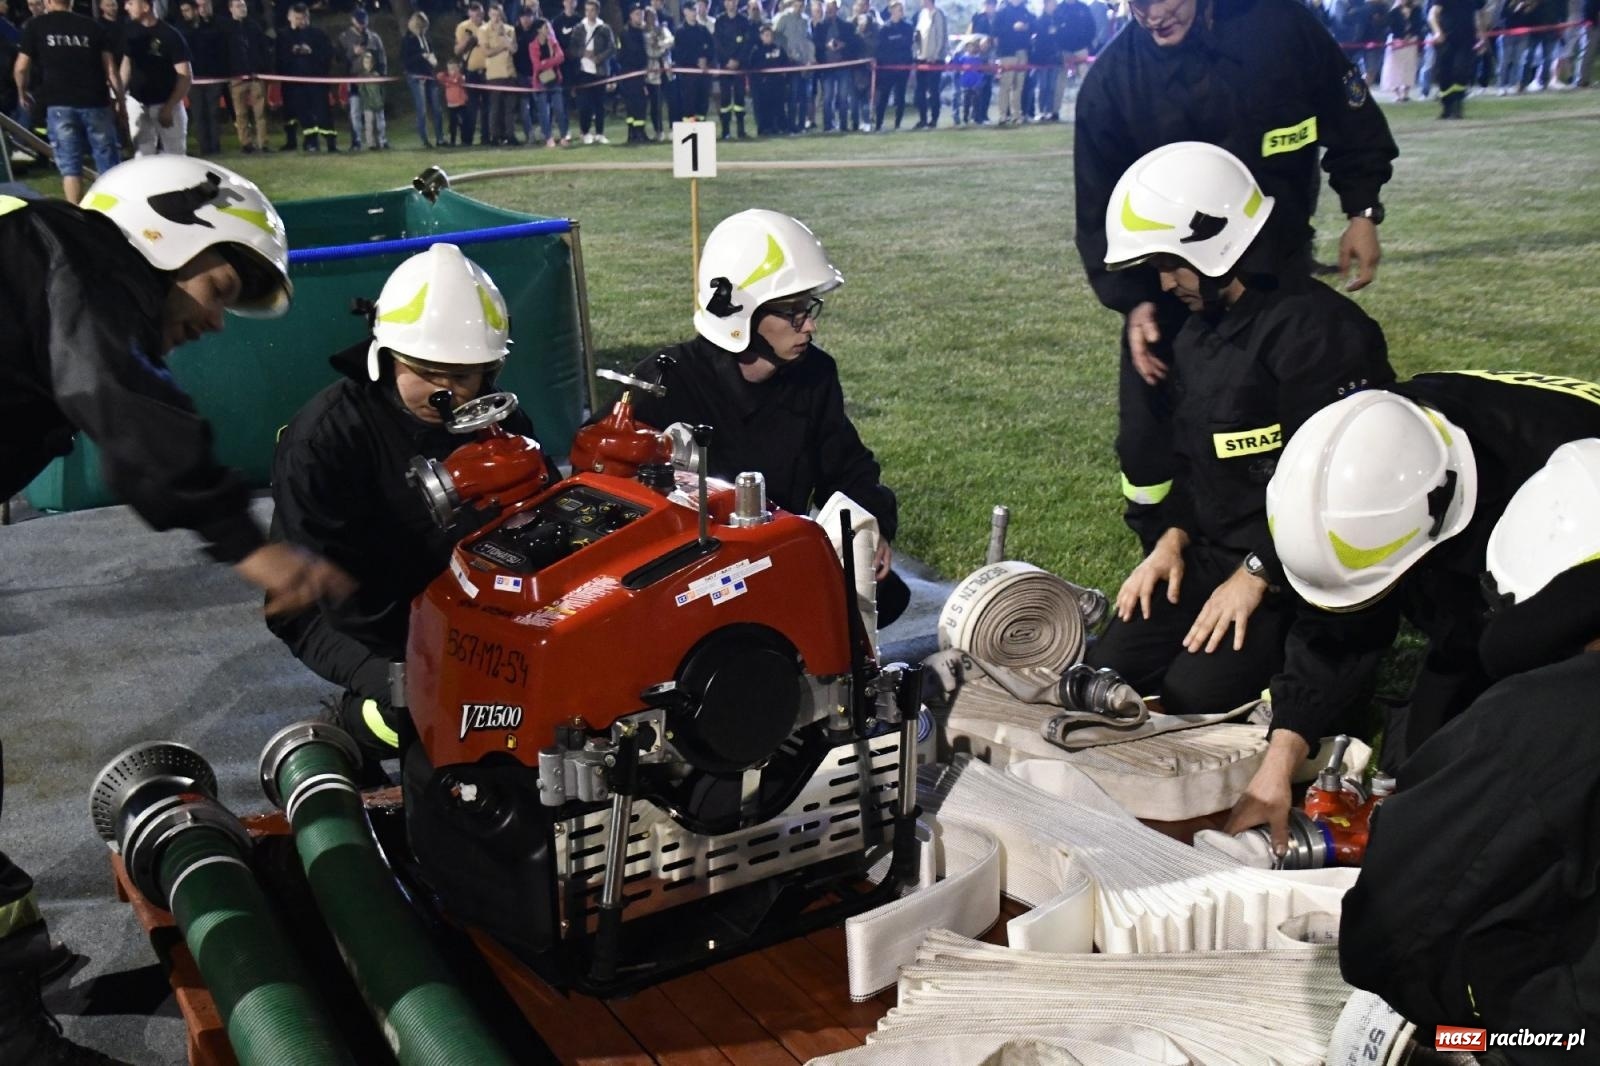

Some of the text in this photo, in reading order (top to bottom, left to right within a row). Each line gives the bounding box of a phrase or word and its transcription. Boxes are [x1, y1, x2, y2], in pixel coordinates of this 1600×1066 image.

[681, 132, 699, 172] 1
[460, 704, 522, 739] VE1500
[1362, 1027, 1386, 1062] 52
